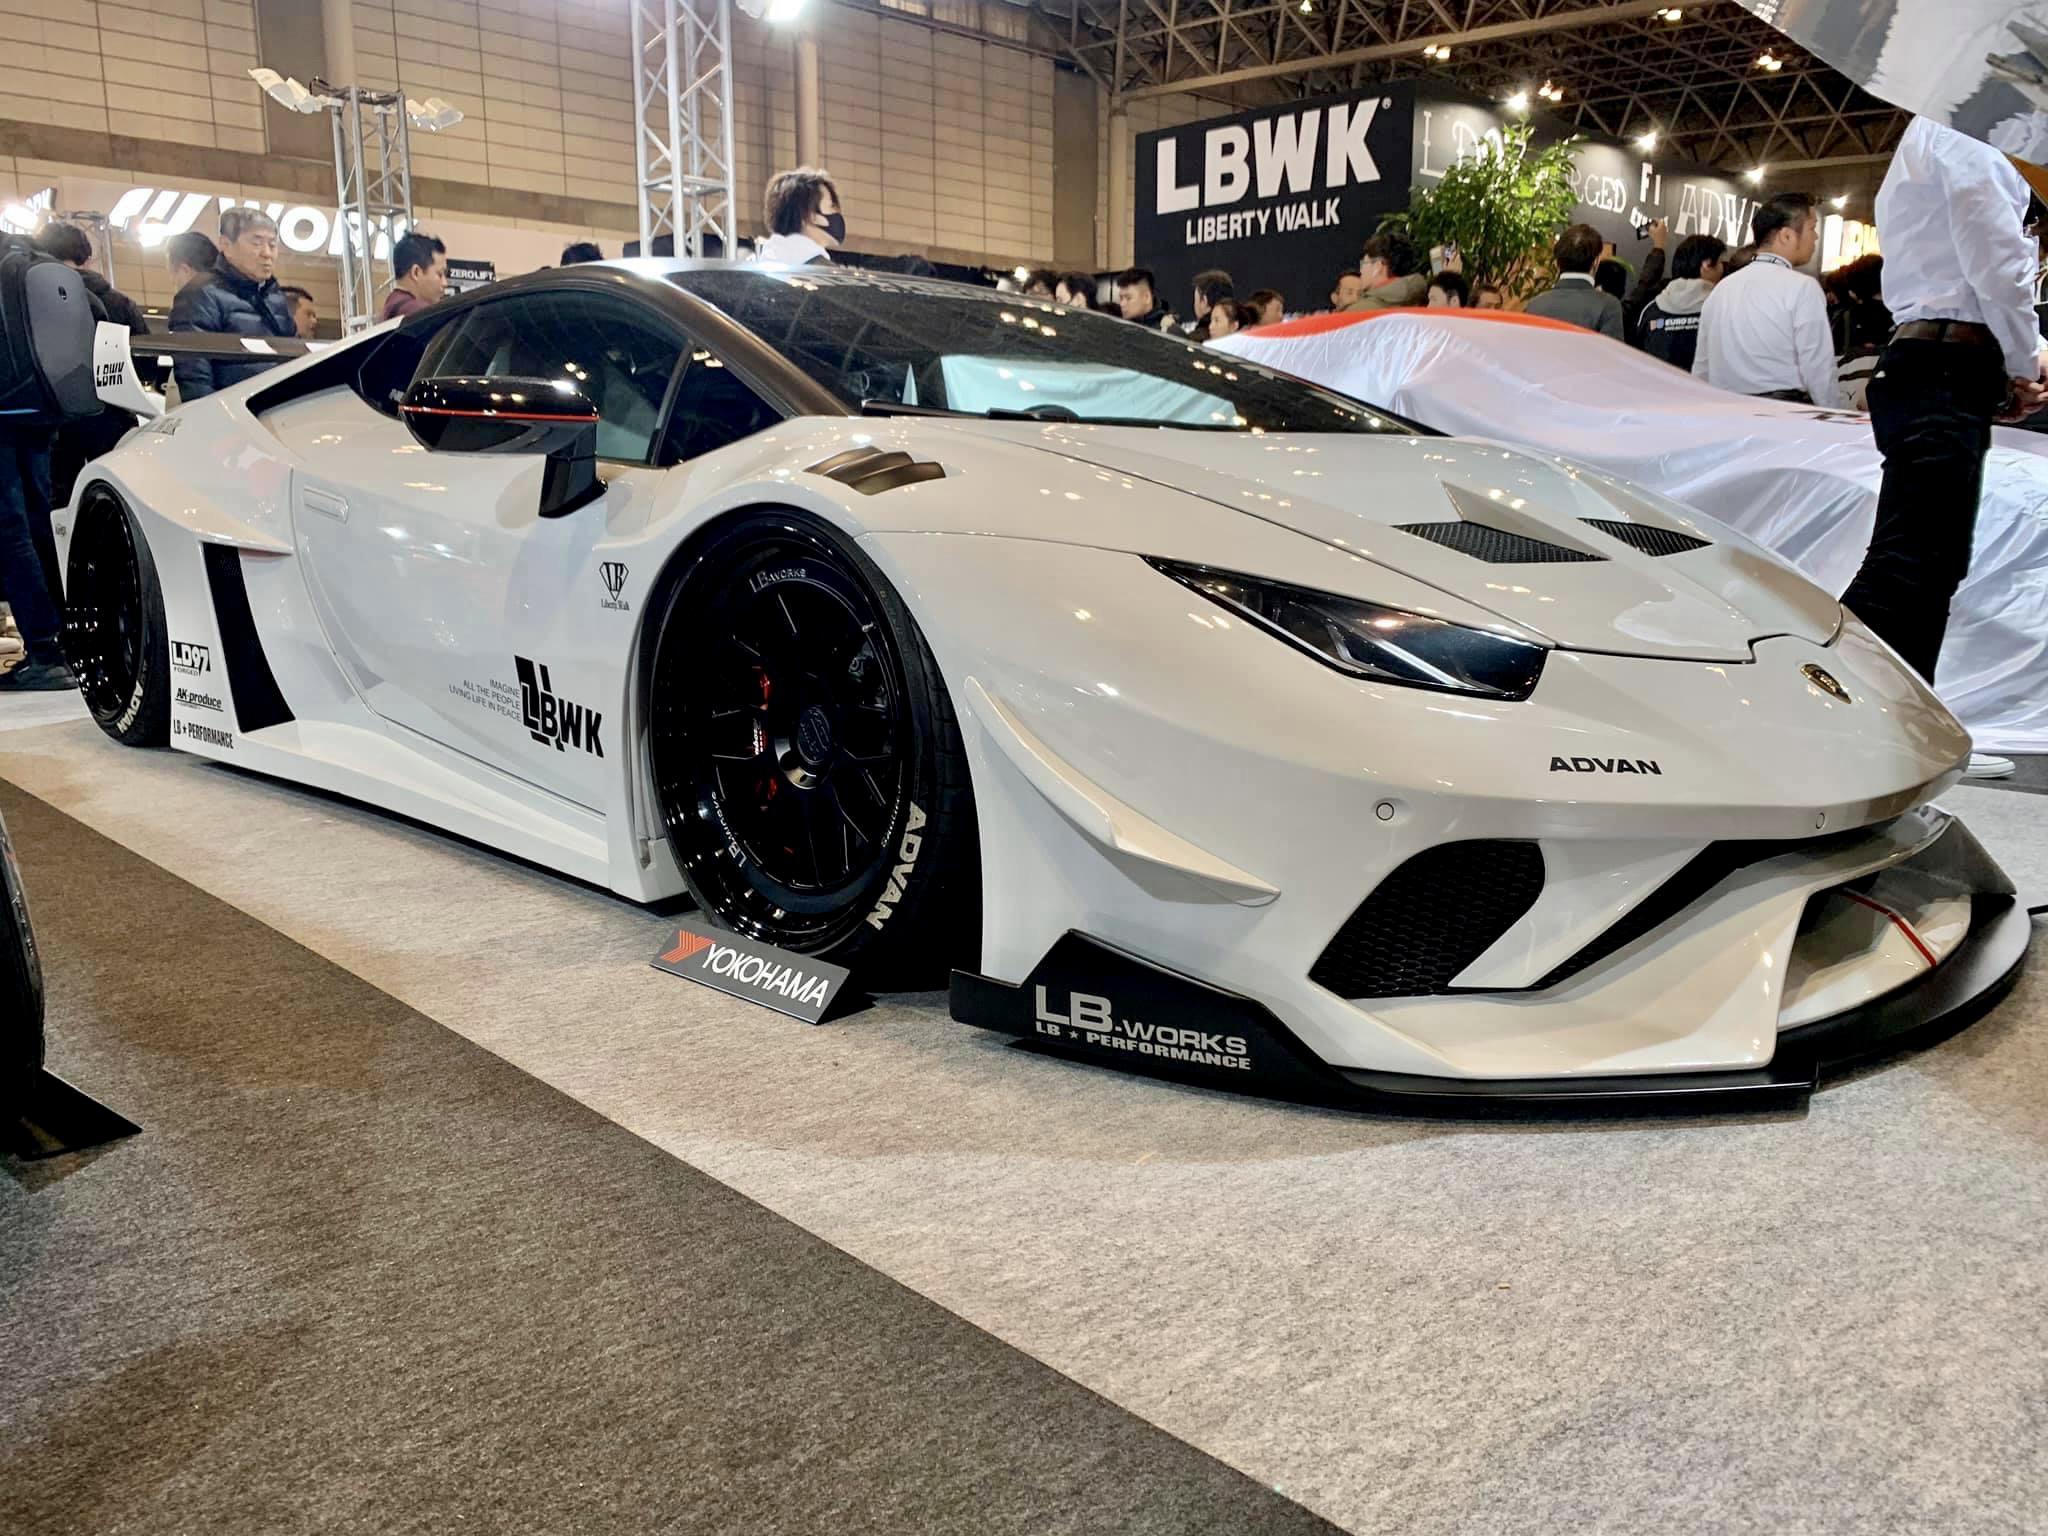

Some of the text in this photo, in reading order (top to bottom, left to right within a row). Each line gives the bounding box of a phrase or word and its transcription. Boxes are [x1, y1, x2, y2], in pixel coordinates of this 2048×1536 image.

[1157, 97, 1381, 215] LBWK
[1186, 197, 1340, 245] LIBERTY WALK
[97, 361, 124, 387] LBWK
[172, 642, 210, 675] LD97
[117, 680, 144, 733] ADVAN
[463, 680, 520, 711] ALL THE PEOPLE
[472, 694, 487, 708] LIFE
[497, 704, 521, 722] PEACE
[490, 679, 520, 698] IMAGINE
[173, 720, 234, 750] LB PERFORMANCE
[521, 682, 604, 759] LBWK
[1550, 756, 1662, 776] ADVAN
[866, 801, 927, 931] ADVAN
[702, 943, 829, 1008] YOKOHAMA
[1035, 1021, 1251, 1070] LB PERFORMANCE
